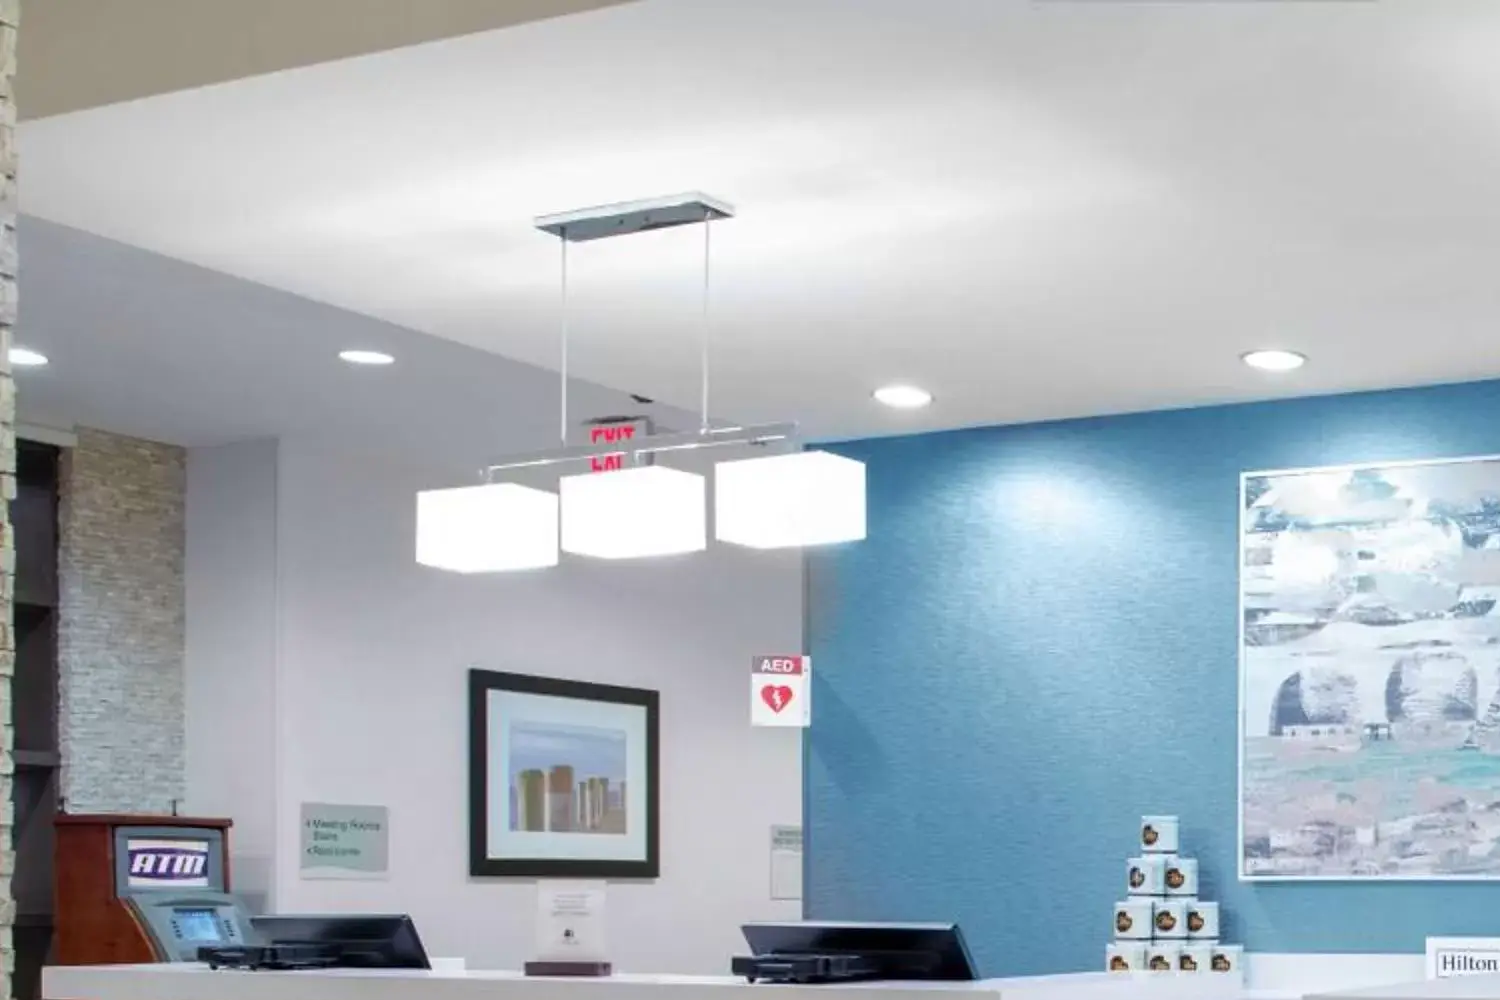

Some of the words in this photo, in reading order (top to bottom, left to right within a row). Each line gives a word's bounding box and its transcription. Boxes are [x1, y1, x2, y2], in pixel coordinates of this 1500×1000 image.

[761, 659, 793, 672] AED
[131, 853, 206, 873] ATM
[1443, 954, 1498, 971] Hilton
